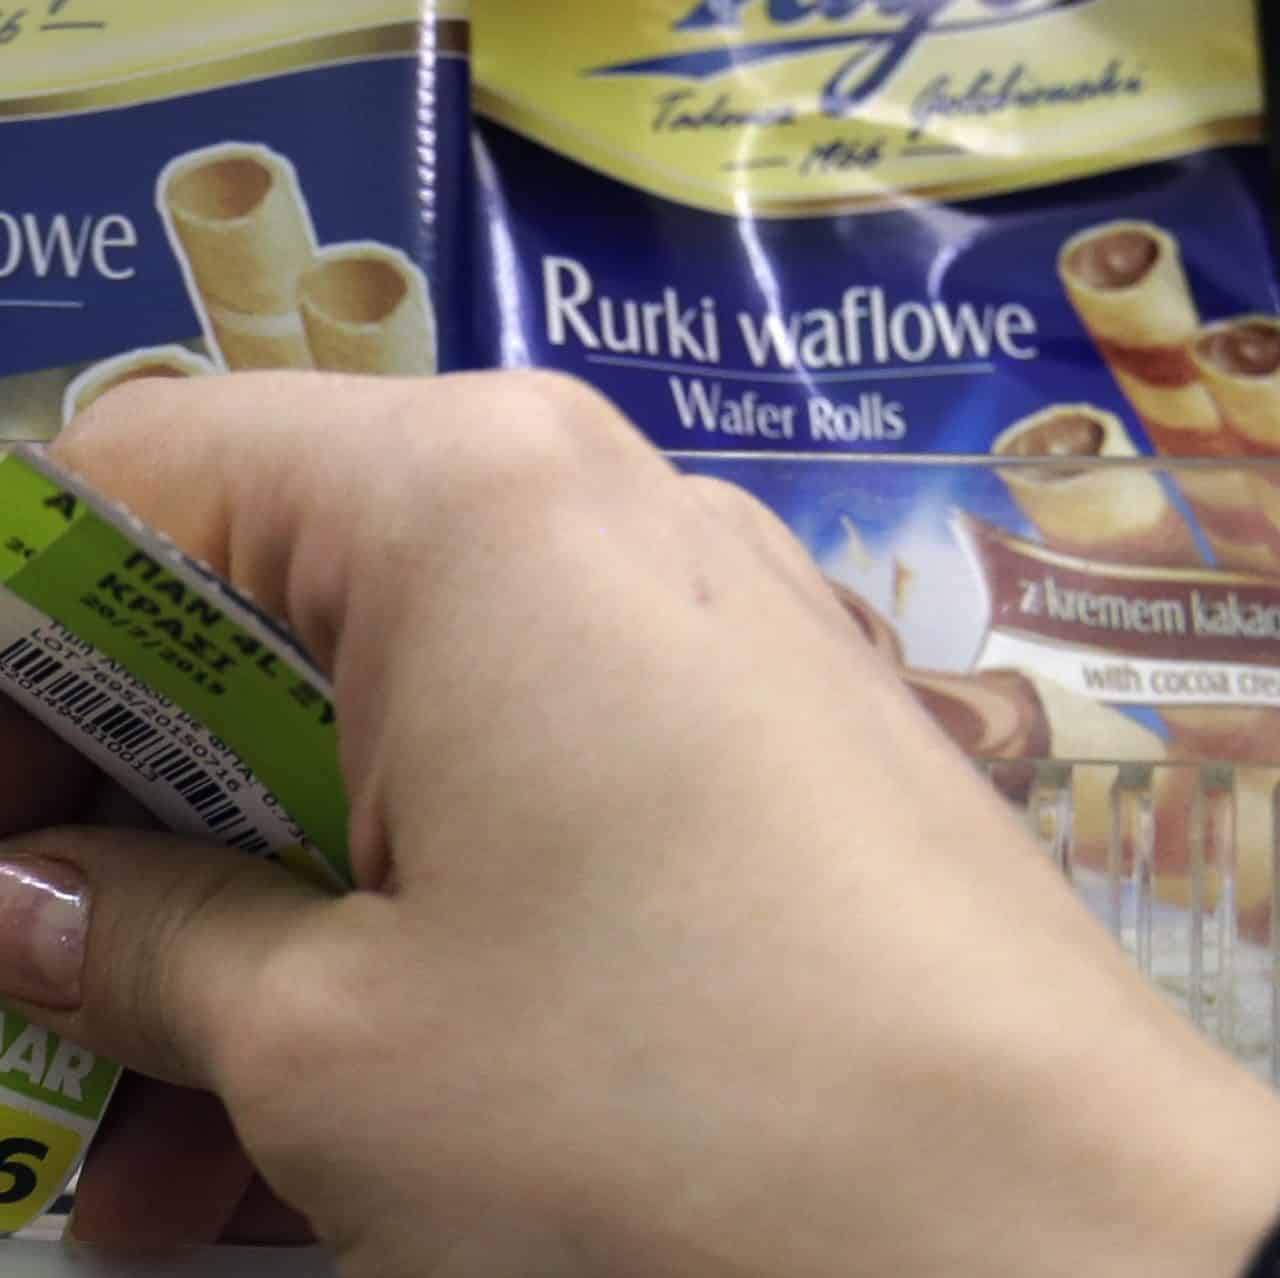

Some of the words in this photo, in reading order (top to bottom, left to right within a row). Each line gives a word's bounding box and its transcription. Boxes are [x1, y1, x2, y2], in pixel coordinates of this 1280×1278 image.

[542, 255, 719, 363] Rurki
[738, 285, 1040, 369] waflowe
[669, 375, 797, 439] Wafer
[808, 393, 907, 442] Rolls
[1043, 575, 1187, 635] kremem
[1081, 663, 1142, 692] with
[1151, 671, 1229, 695] cocoa
